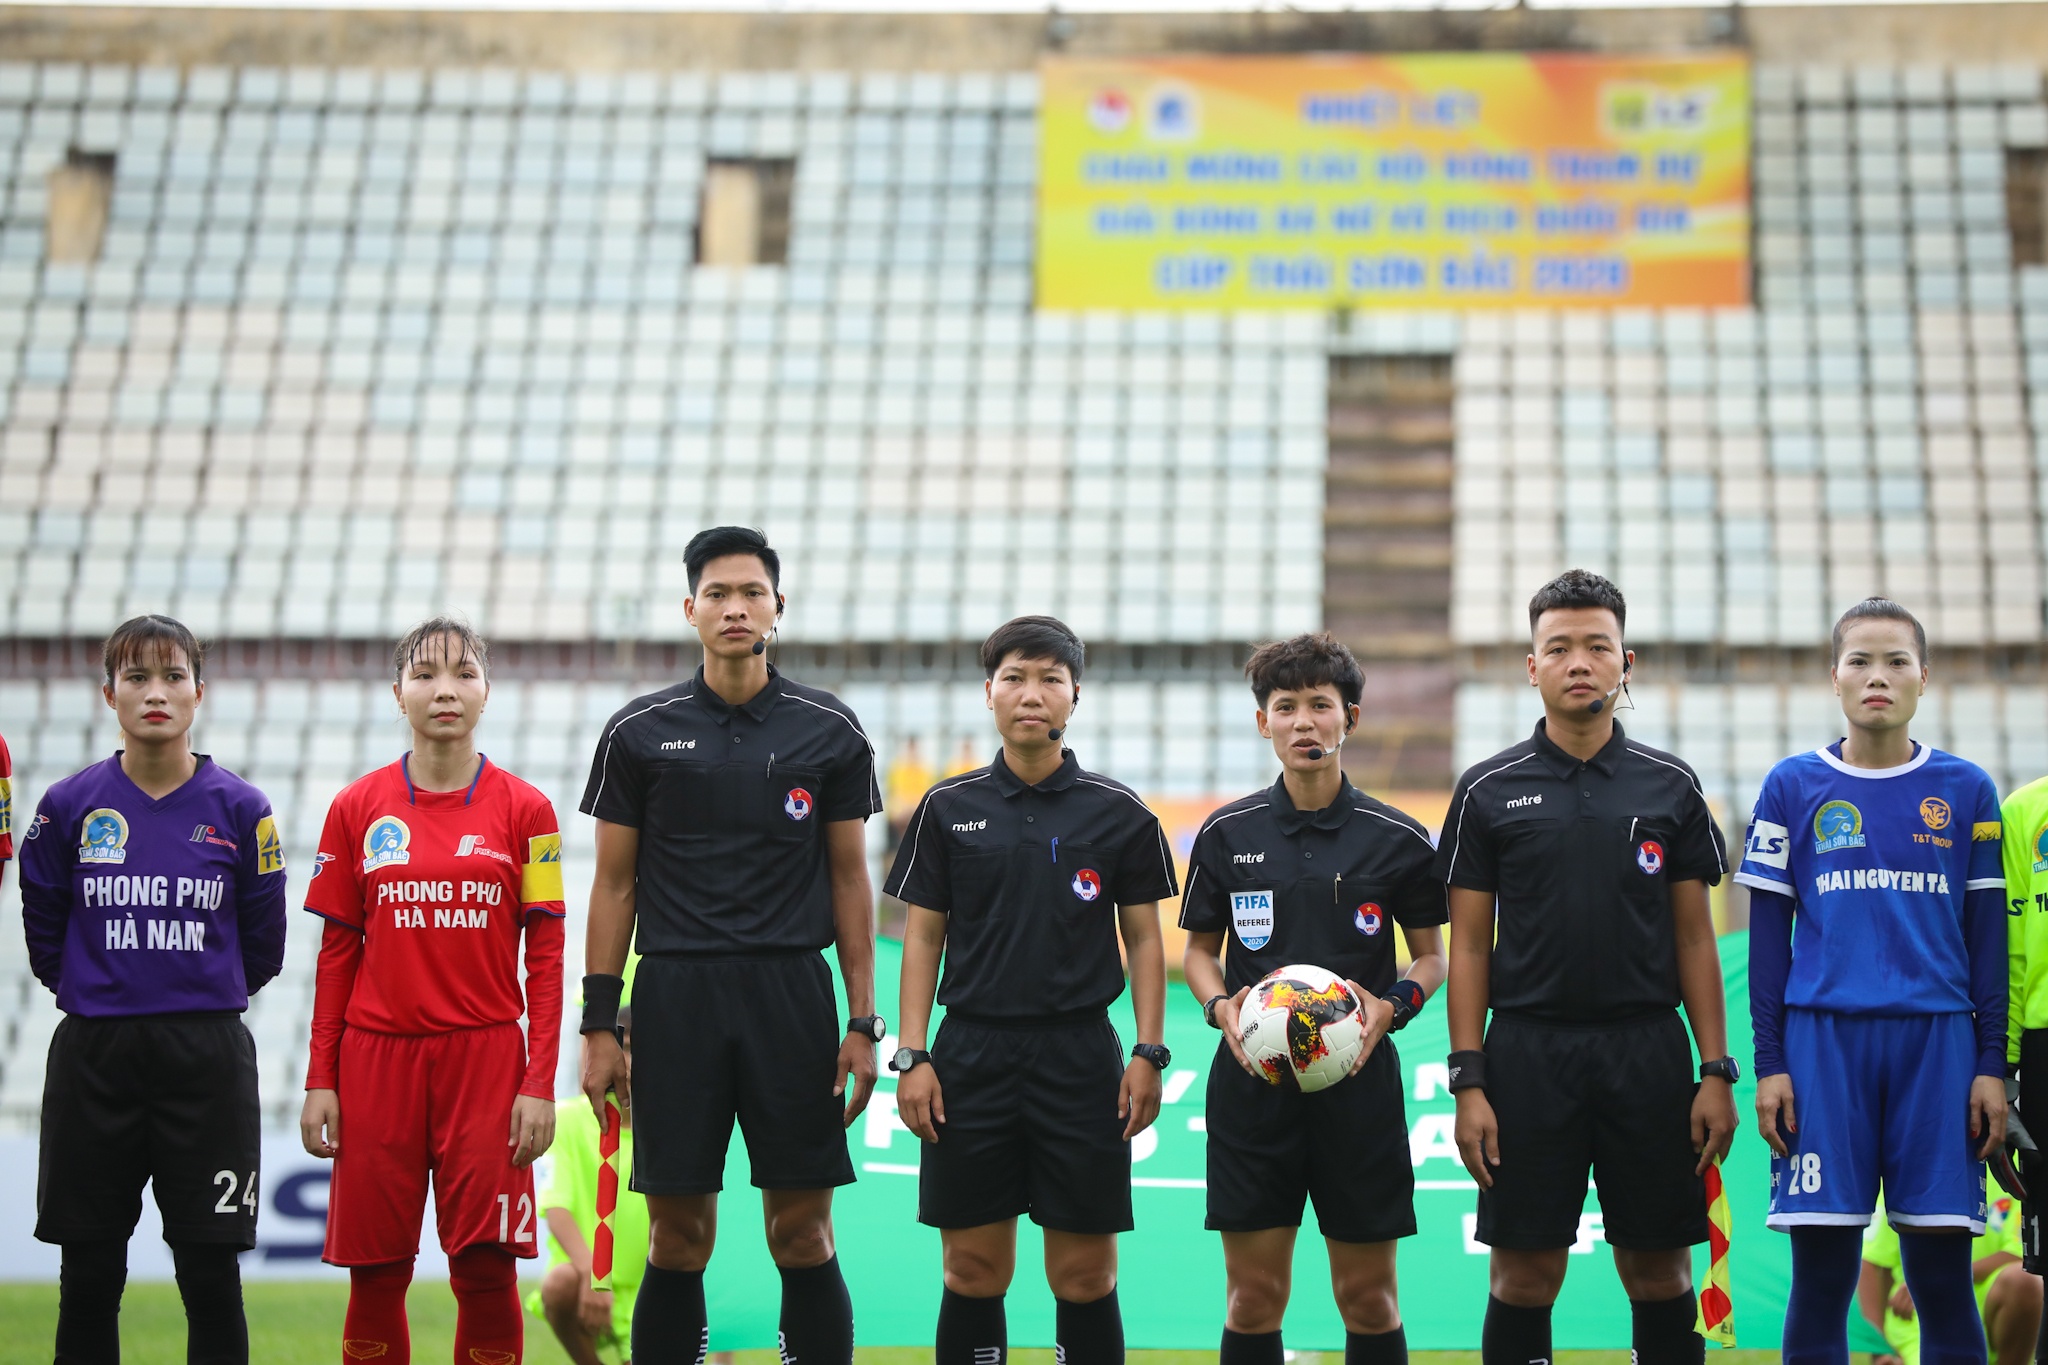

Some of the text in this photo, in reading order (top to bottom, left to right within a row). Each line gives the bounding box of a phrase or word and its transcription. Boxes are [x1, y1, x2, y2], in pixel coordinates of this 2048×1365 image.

[83, 875, 224, 911] PHONG PHÚ
[377, 881, 502, 907] PHONG PHÚ
[1853, 868, 1925, 893] NGUYEN
[394, 905, 489, 930] HÀ NAM
[1235, 895, 1269, 910] FIFA
[105, 912, 206, 951] HÀ NAM
[1237, 918, 1271, 928] REFEREE
[1788, 1152, 1821, 1196] 28
[213, 1169, 257, 1217] 24
[497, 1193, 533, 1243] 12
